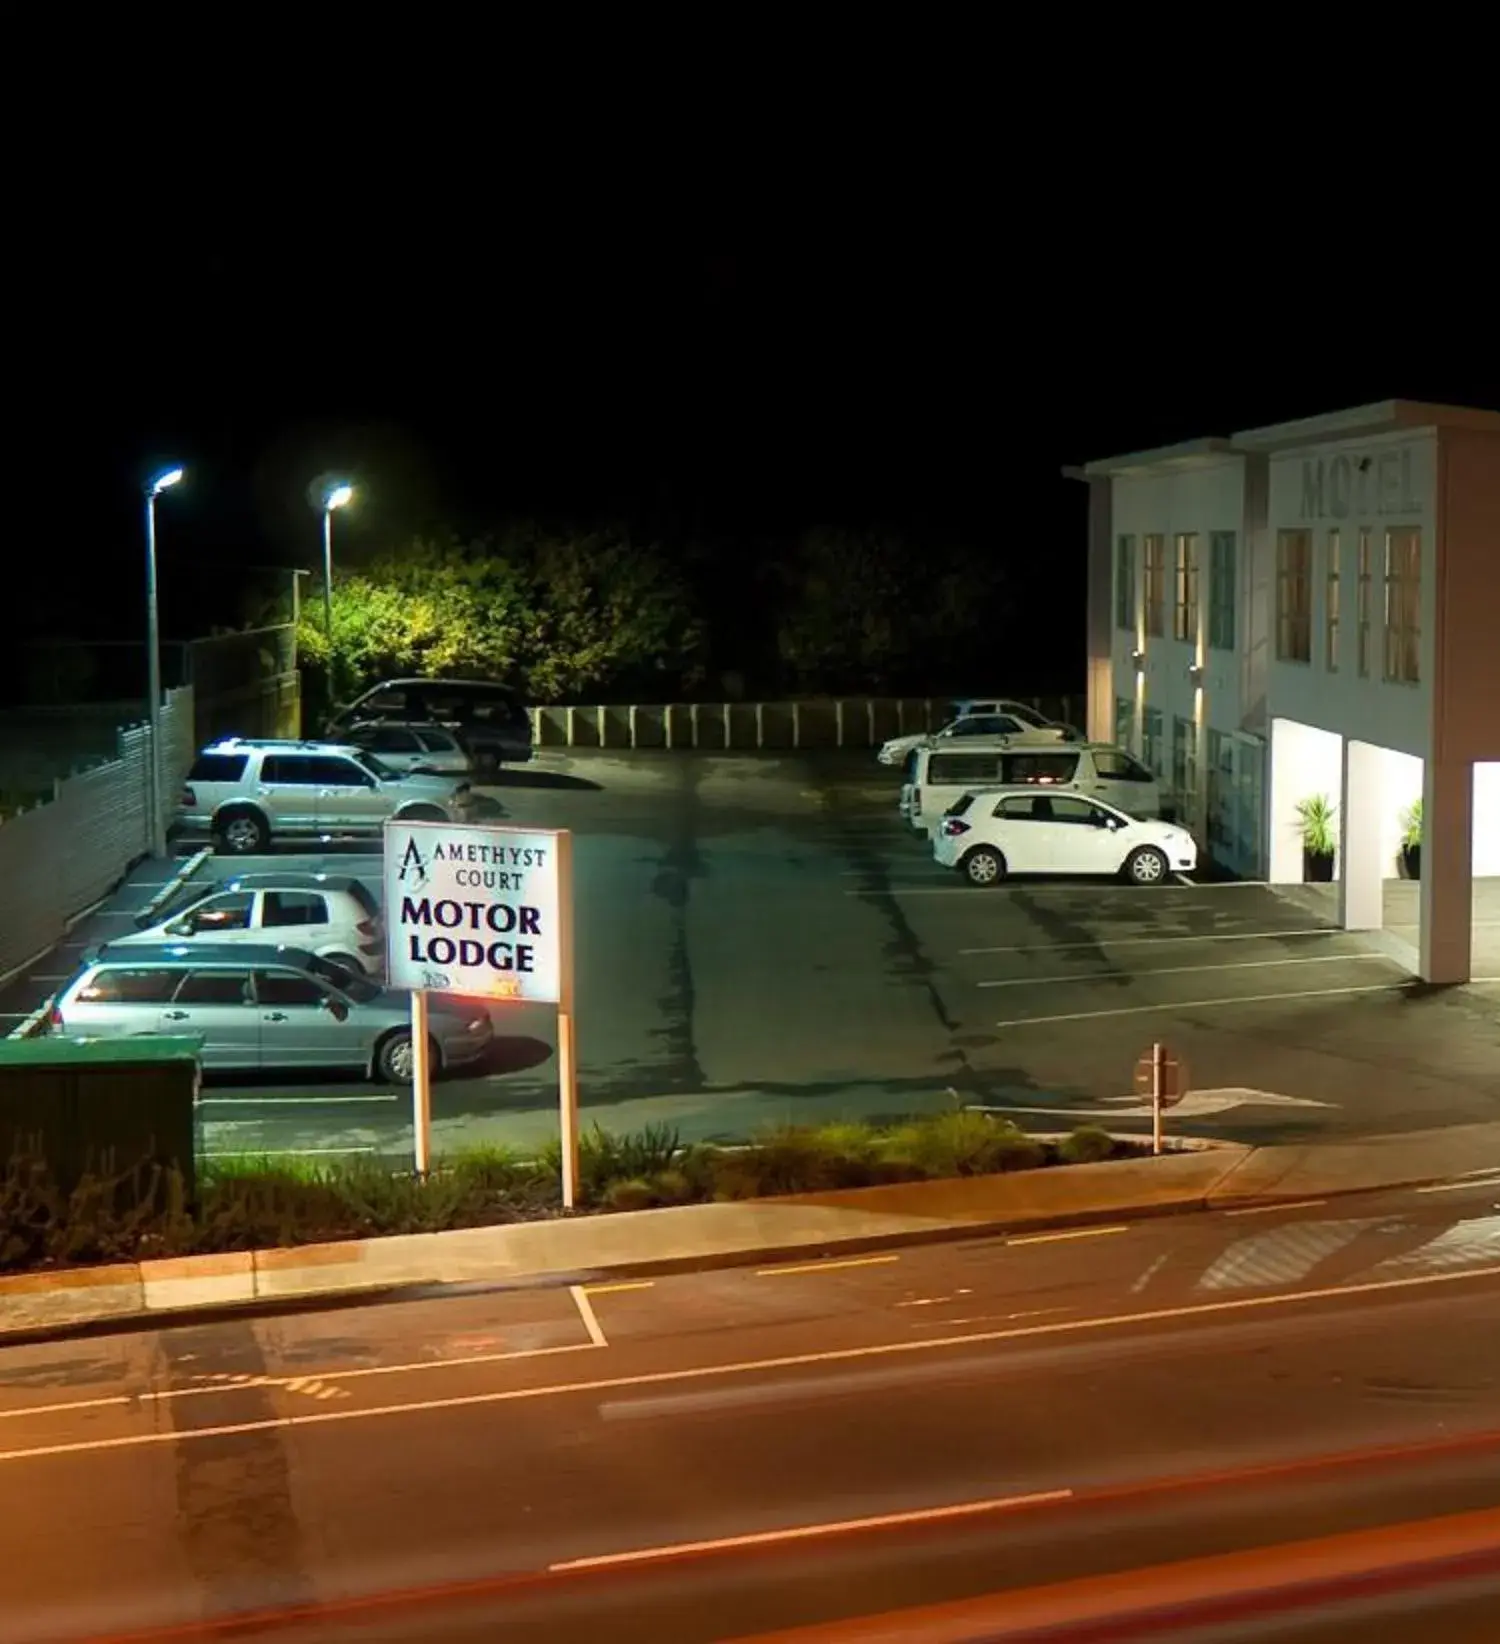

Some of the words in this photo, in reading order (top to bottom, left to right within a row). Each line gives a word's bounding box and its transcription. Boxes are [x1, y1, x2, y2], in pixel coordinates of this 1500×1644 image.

[433, 842, 547, 867] AMETHYST
[455, 869, 523, 891] COURT
[401, 897, 541, 935] MOTOR
[410, 935, 534, 973] LODGE
